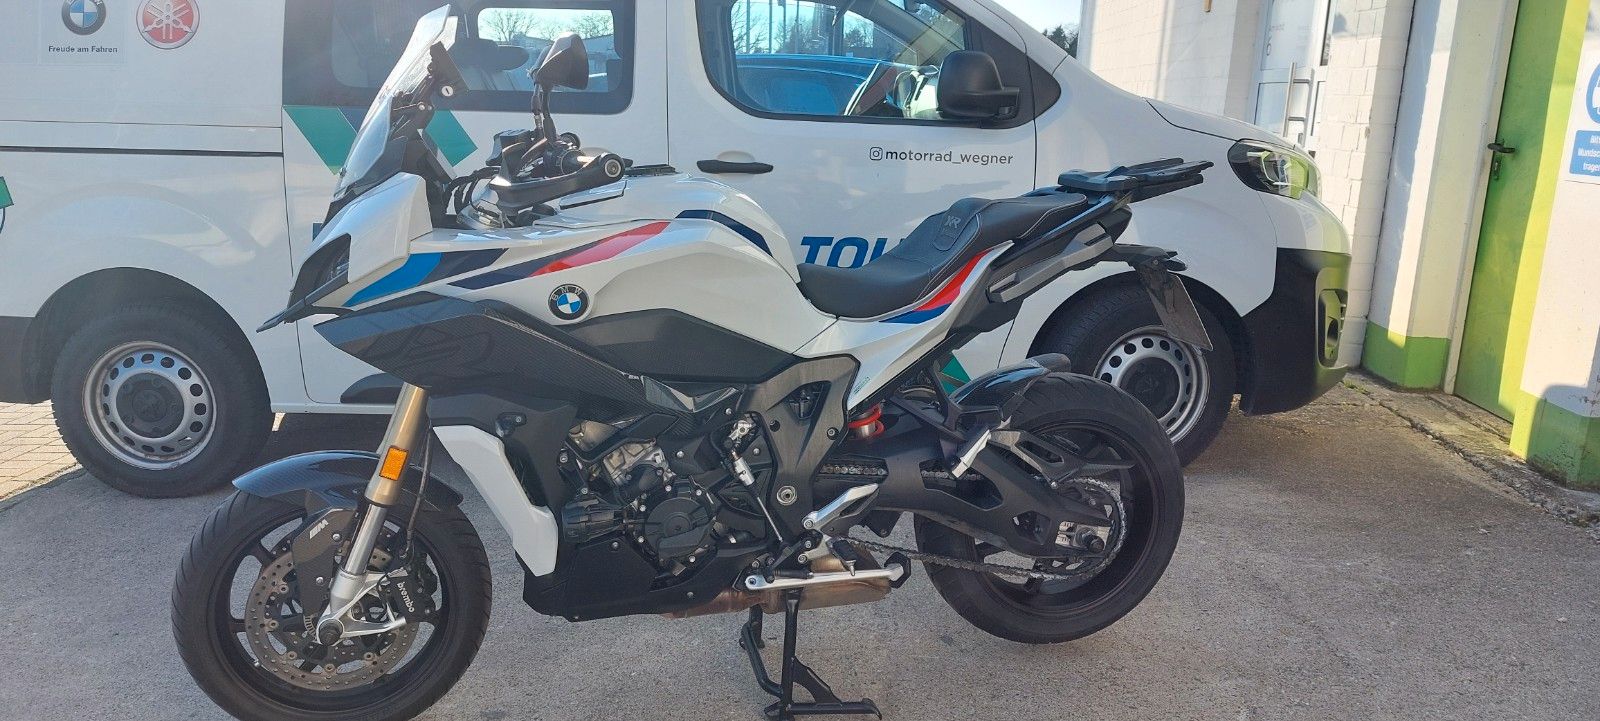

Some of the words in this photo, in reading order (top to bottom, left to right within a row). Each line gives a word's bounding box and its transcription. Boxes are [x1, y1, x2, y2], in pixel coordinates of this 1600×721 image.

[48, 45, 75, 53] Freude
[91, 45, 118, 53] Fahren
[885, 150, 1014, 166] motorrad_wegner
[396, 581, 415, 613] brembo
